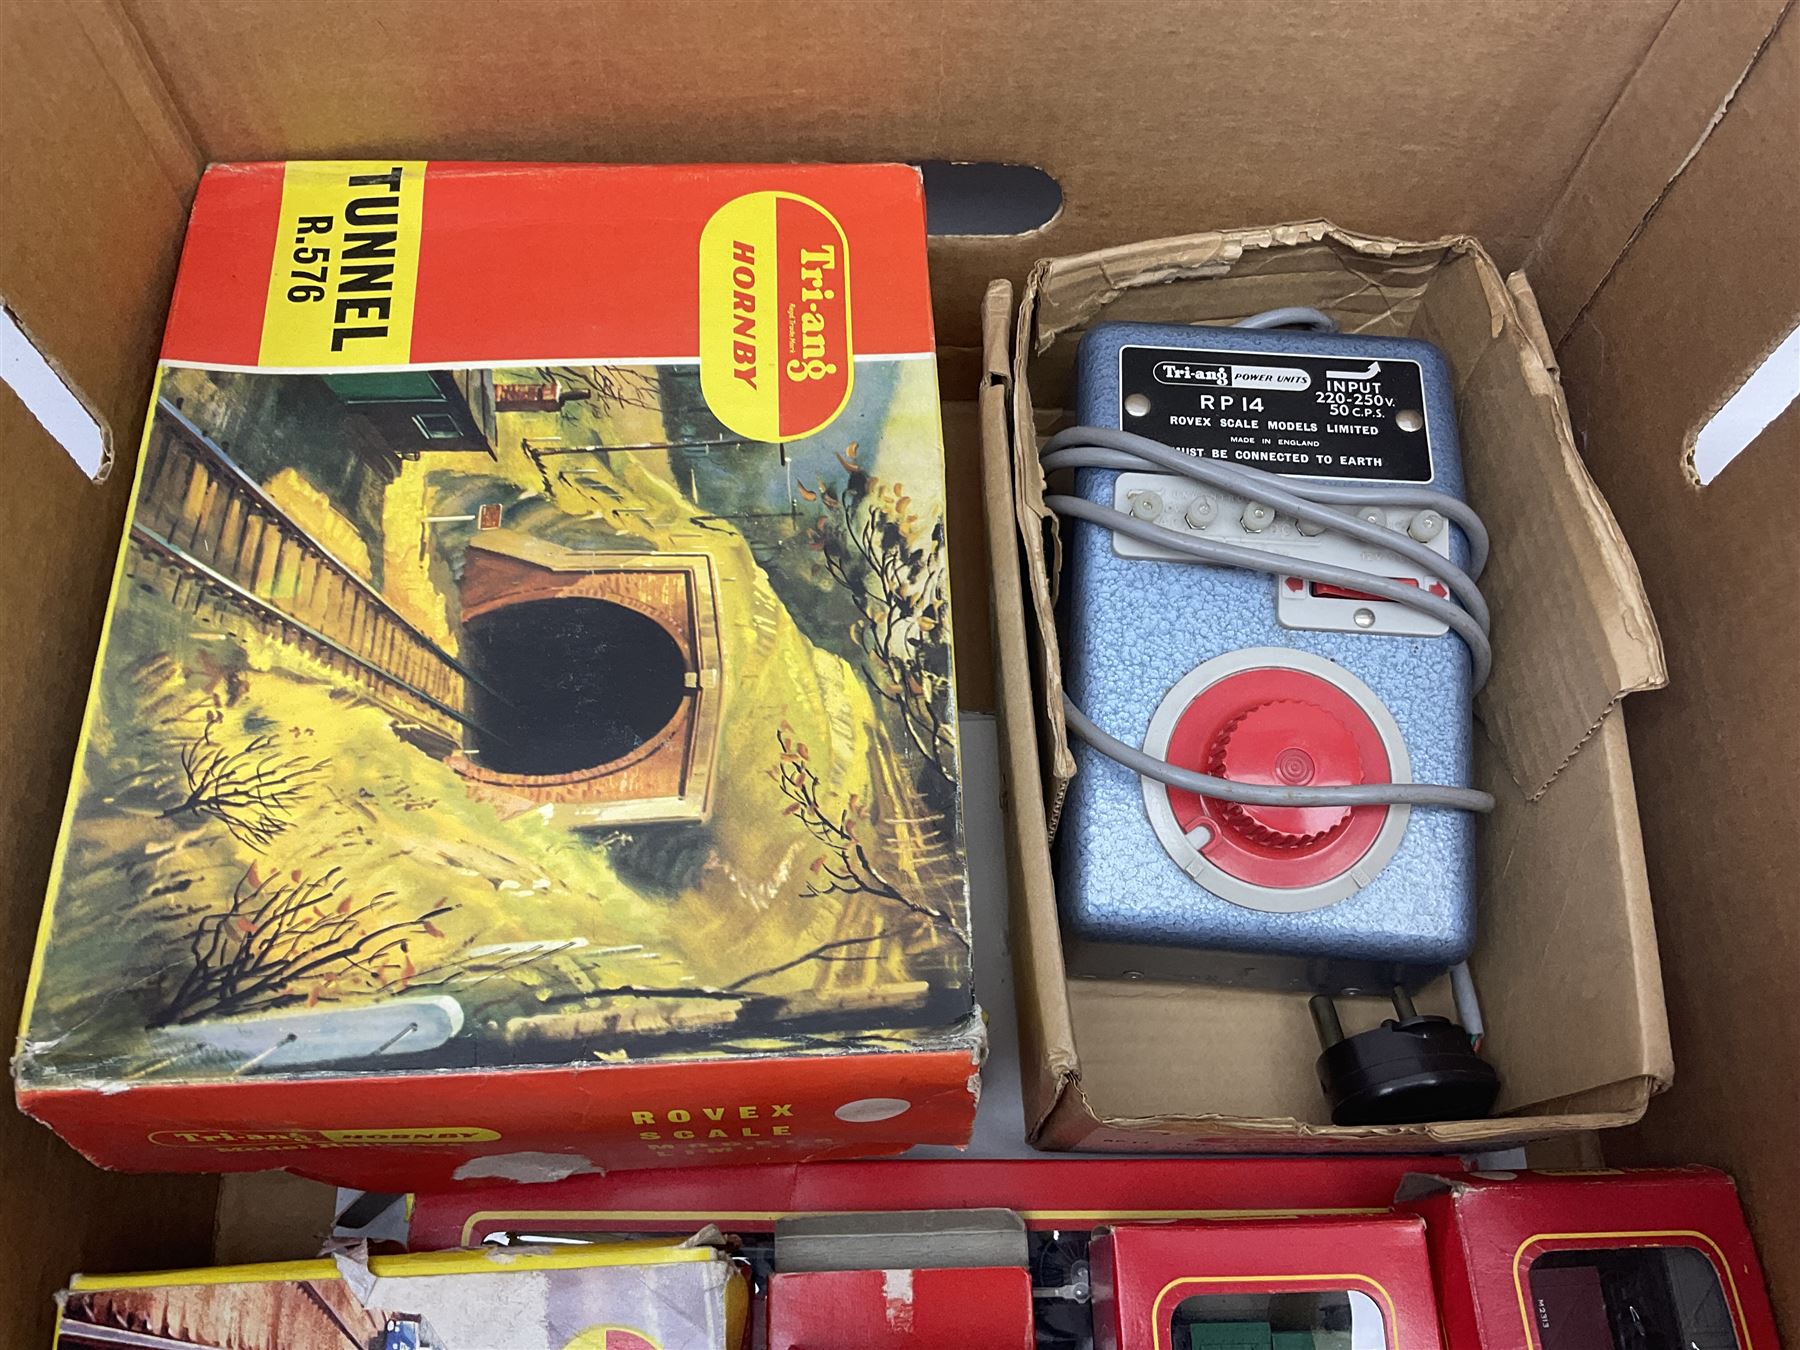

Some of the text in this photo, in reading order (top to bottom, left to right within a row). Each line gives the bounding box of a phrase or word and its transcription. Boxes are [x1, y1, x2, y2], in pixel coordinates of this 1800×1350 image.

[287, 215, 334, 303] R.576
[331, 167, 403, 352] TUNNEL
[732, 240, 758, 391] HORNBY
[1163, 365, 1308, 386] Tri-ang POWER UNITS
[1326, 380, 1381, 394] INPUT
[1242, 396, 1265, 412] 14
[1329, 404, 1385, 418] 50 C.P.S.
[1169, 415, 1379, 435] ROVEX SCALE MODELS LIMITED
[1230, 436, 1320, 447] MADE IN ENGLAND
[1173, 446, 1383, 467] UST BE CONNECTED TO EARTH
[631, 1104, 794, 1125] ROVEX
[341, 1132, 479, 1140] HORNBY
[639, 1125, 792, 1140] SCALE
